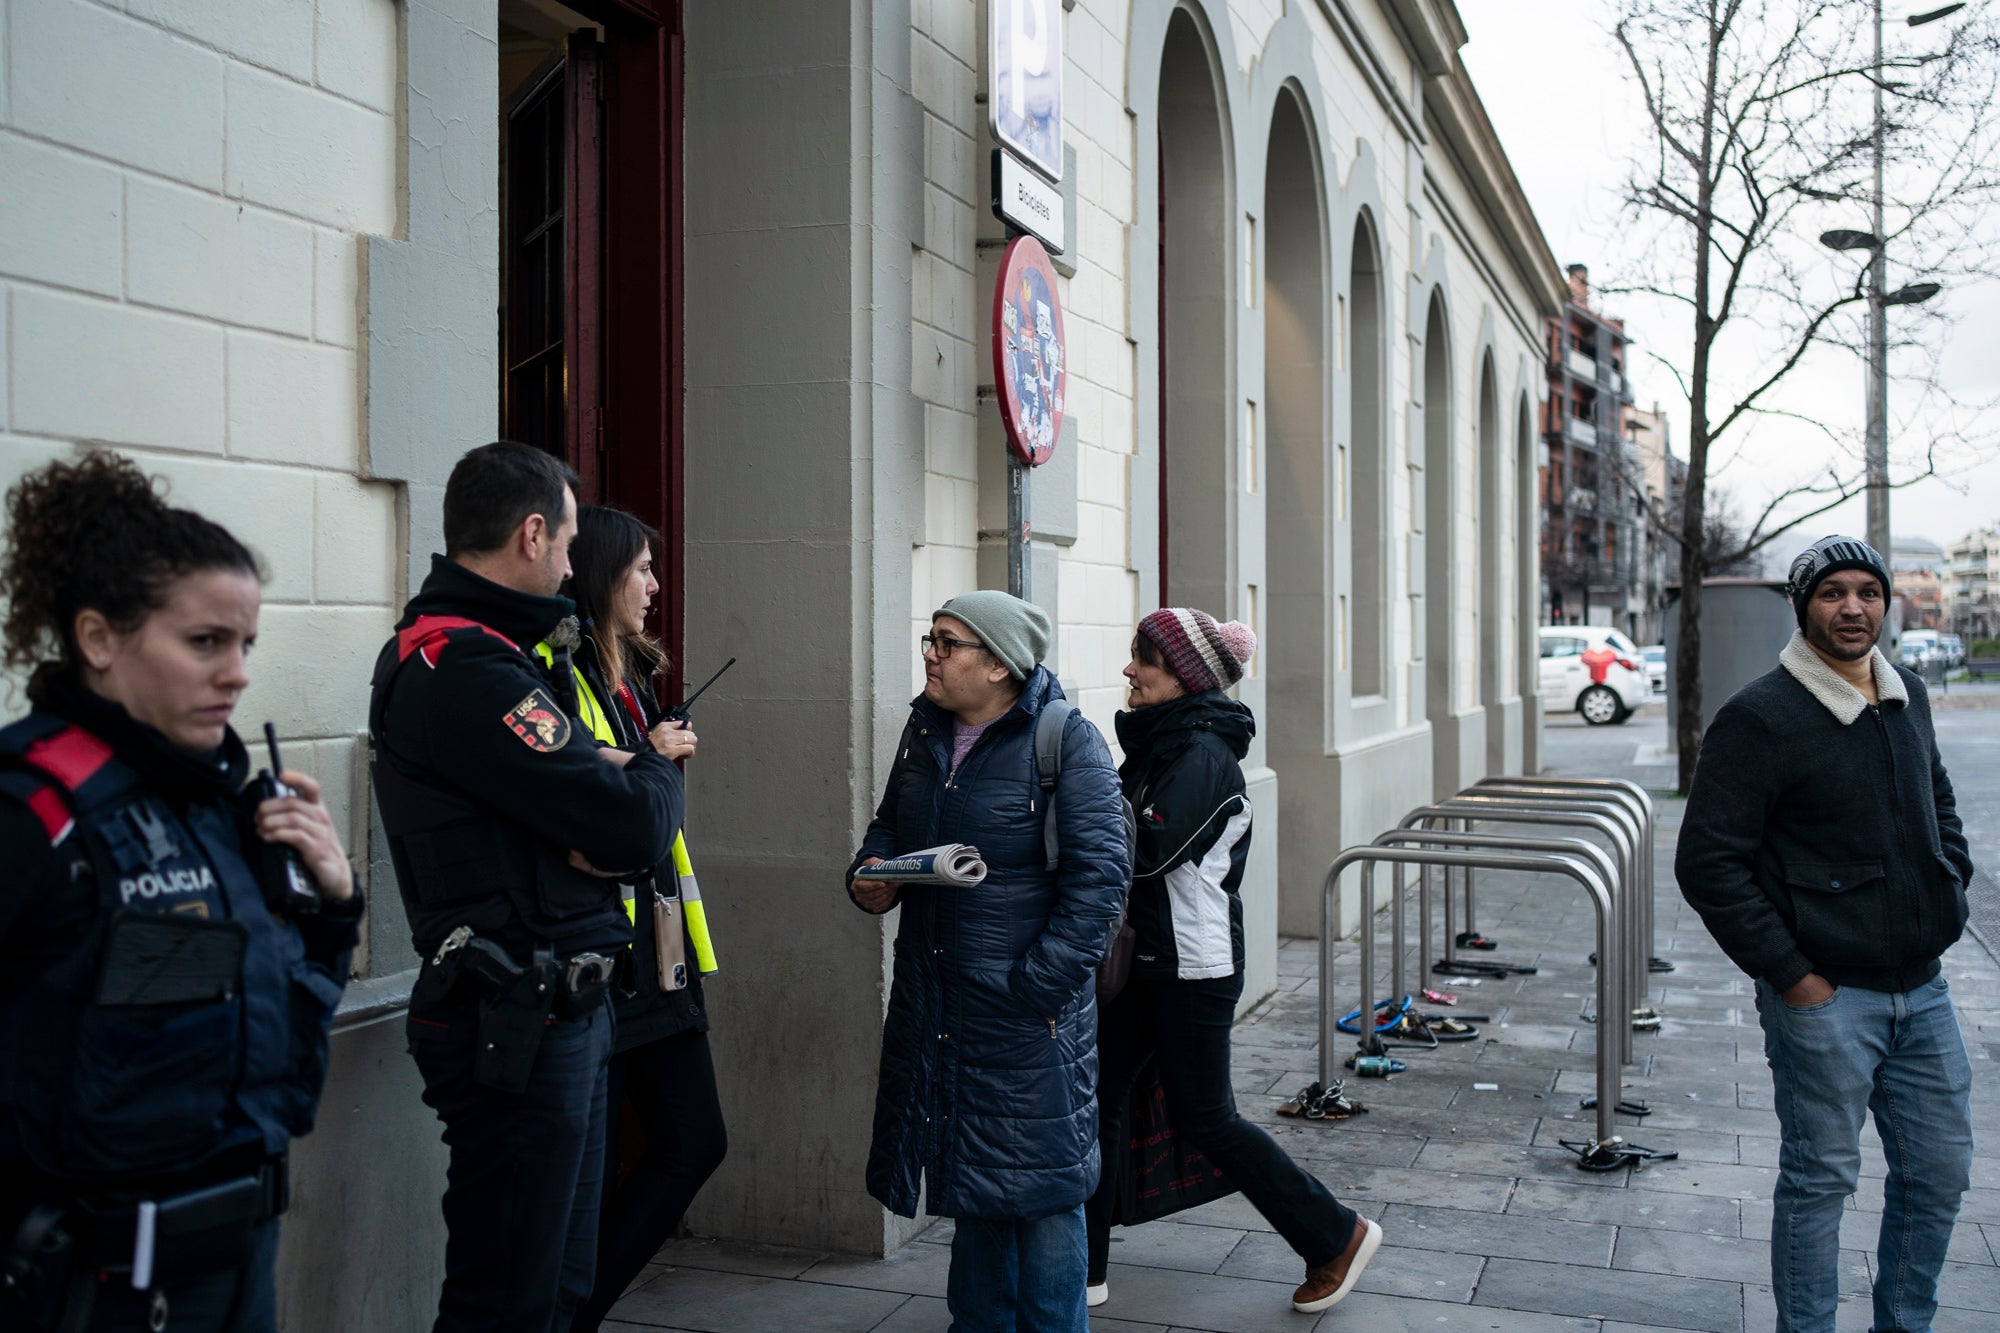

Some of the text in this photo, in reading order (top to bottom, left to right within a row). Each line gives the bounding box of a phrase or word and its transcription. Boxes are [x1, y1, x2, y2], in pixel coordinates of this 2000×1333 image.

[1018, 182, 1050, 221] Bicicletes
[516, 697, 538, 717] USC
[120, 866, 217, 904] POLICIA
